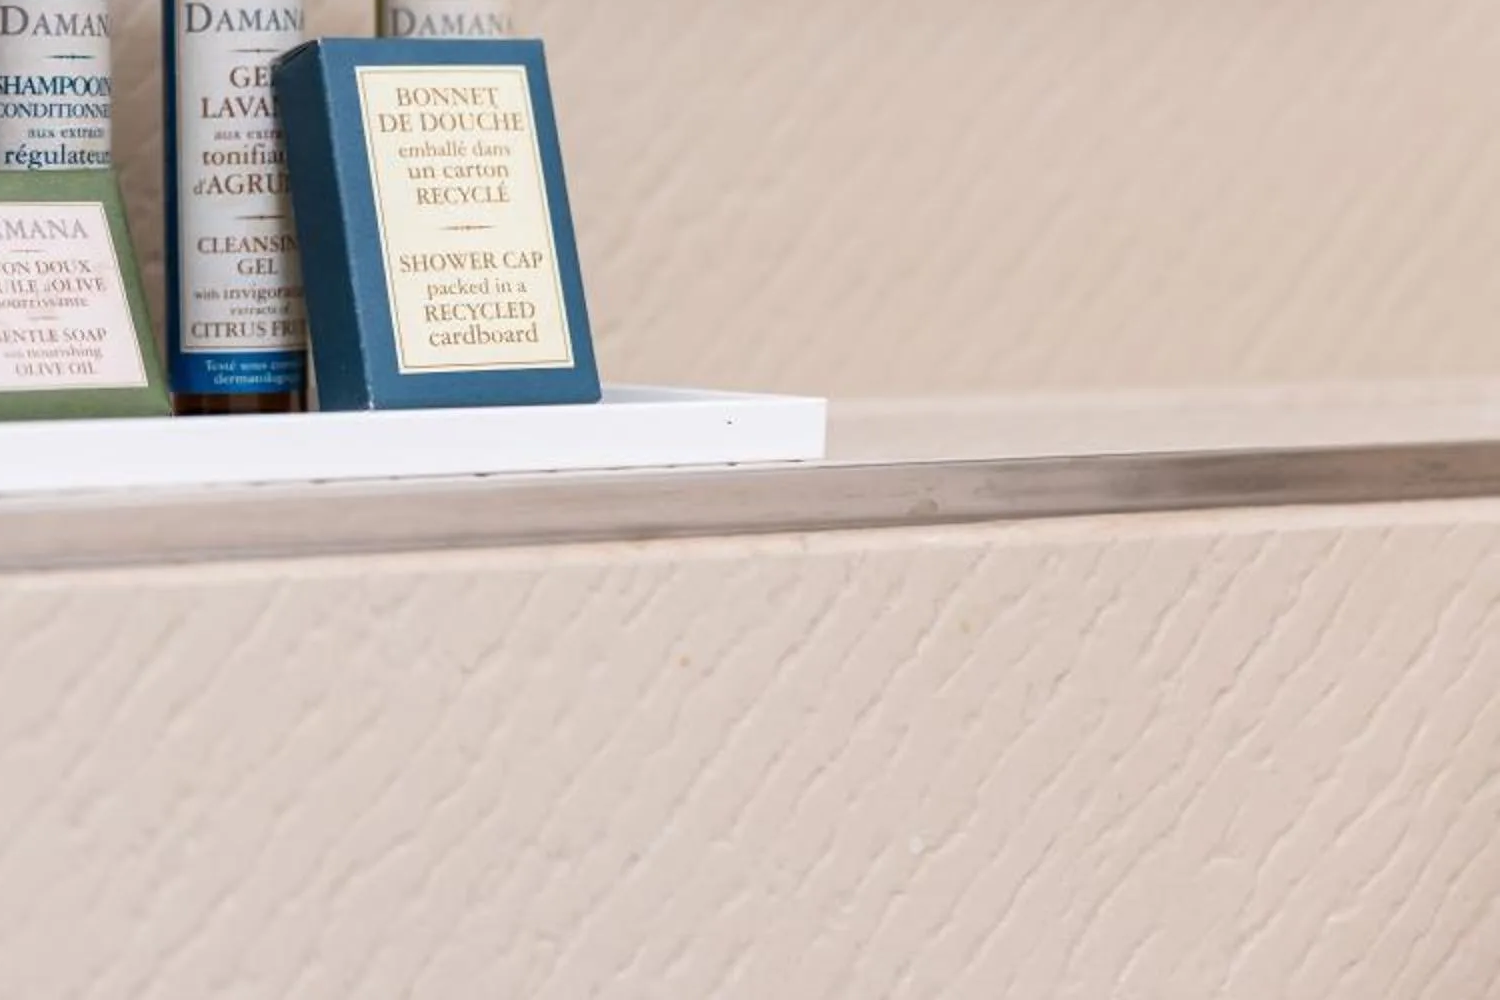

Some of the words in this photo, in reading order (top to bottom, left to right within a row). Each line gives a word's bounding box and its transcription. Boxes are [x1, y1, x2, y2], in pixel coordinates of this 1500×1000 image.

[396, 86, 499, 107] BONNET
[201, 96, 275, 119] LAVA
[378, 113, 413, 133] DE
[420, 111, 525, 132] DOUCHE
[27, 127, 56, 139] aux
[399, 140, 467, 158] emballé
[472, 140, 511, 157] dans
[408, 165, 436, 179] un
[443, 163, 510, 179] carton
[193, 172, 288, 195] d'AGRU
[416, 180, 511, 206] RECYCLÉ
[197, 235, 297, 253] CLEANSIN
[35, 259, 92, 275] DOUX
[236, 257, 279, 275] GEL
[399, 252, 498, 273] SHOWER
[502, 251, 543, 269] CAP
[426, 278, 489, 300] packed
[495, 278, 513, 293] in
[517, 281, 528, 293] a
[424, 301, 536, 322] RECYCLED
[63, 327, 108, 343] SOAP
[191, 321, 268, 339] CITRUS
[429, 322, 540, 346] cardboard
[14, 361, 63, 376] OLIVE
[67, 360, 99, 375] OIL
